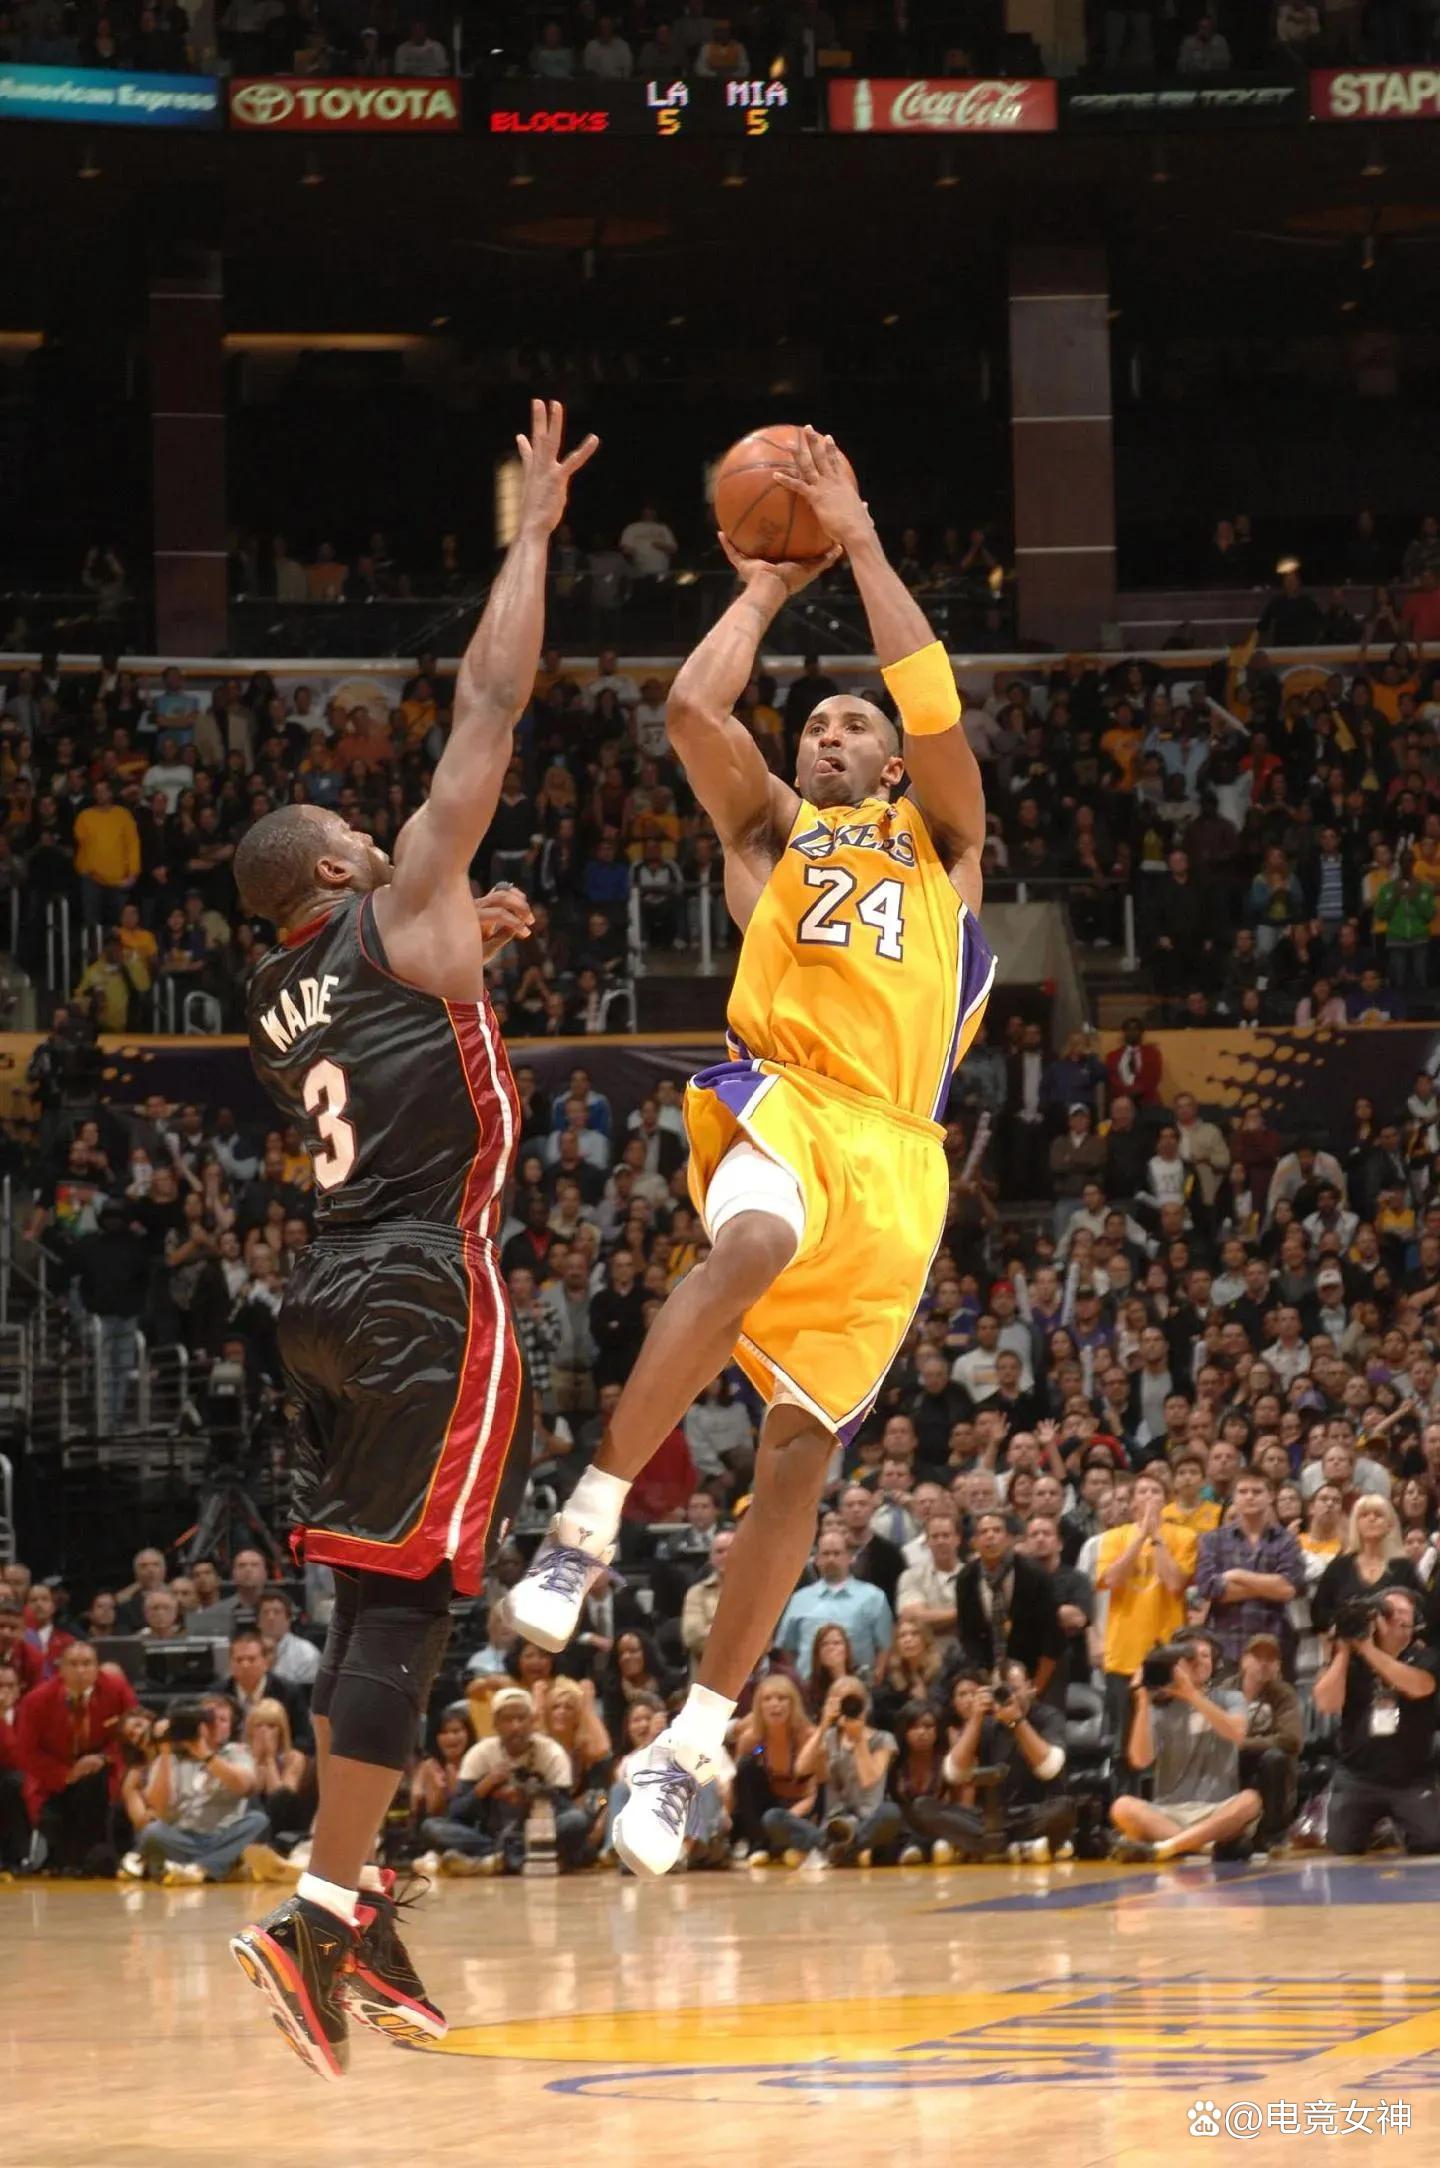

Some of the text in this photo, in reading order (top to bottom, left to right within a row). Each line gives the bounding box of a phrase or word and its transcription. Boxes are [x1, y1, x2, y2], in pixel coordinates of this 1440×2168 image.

[117, 84, 217, 112] Express
[296, 87, 457, 120] TOYOTA
[647, 81, 788, 106] LA MIA
[1329, 70, 1440, 117] STAP
[490, 111, 609, 133] BLOCKS
[657, 109, 769, 136] 5 5
[796, 863, 905, 963] 24
[260, 974, 339, 1053] WADE
[301, 1056, 359, 1193] 3
